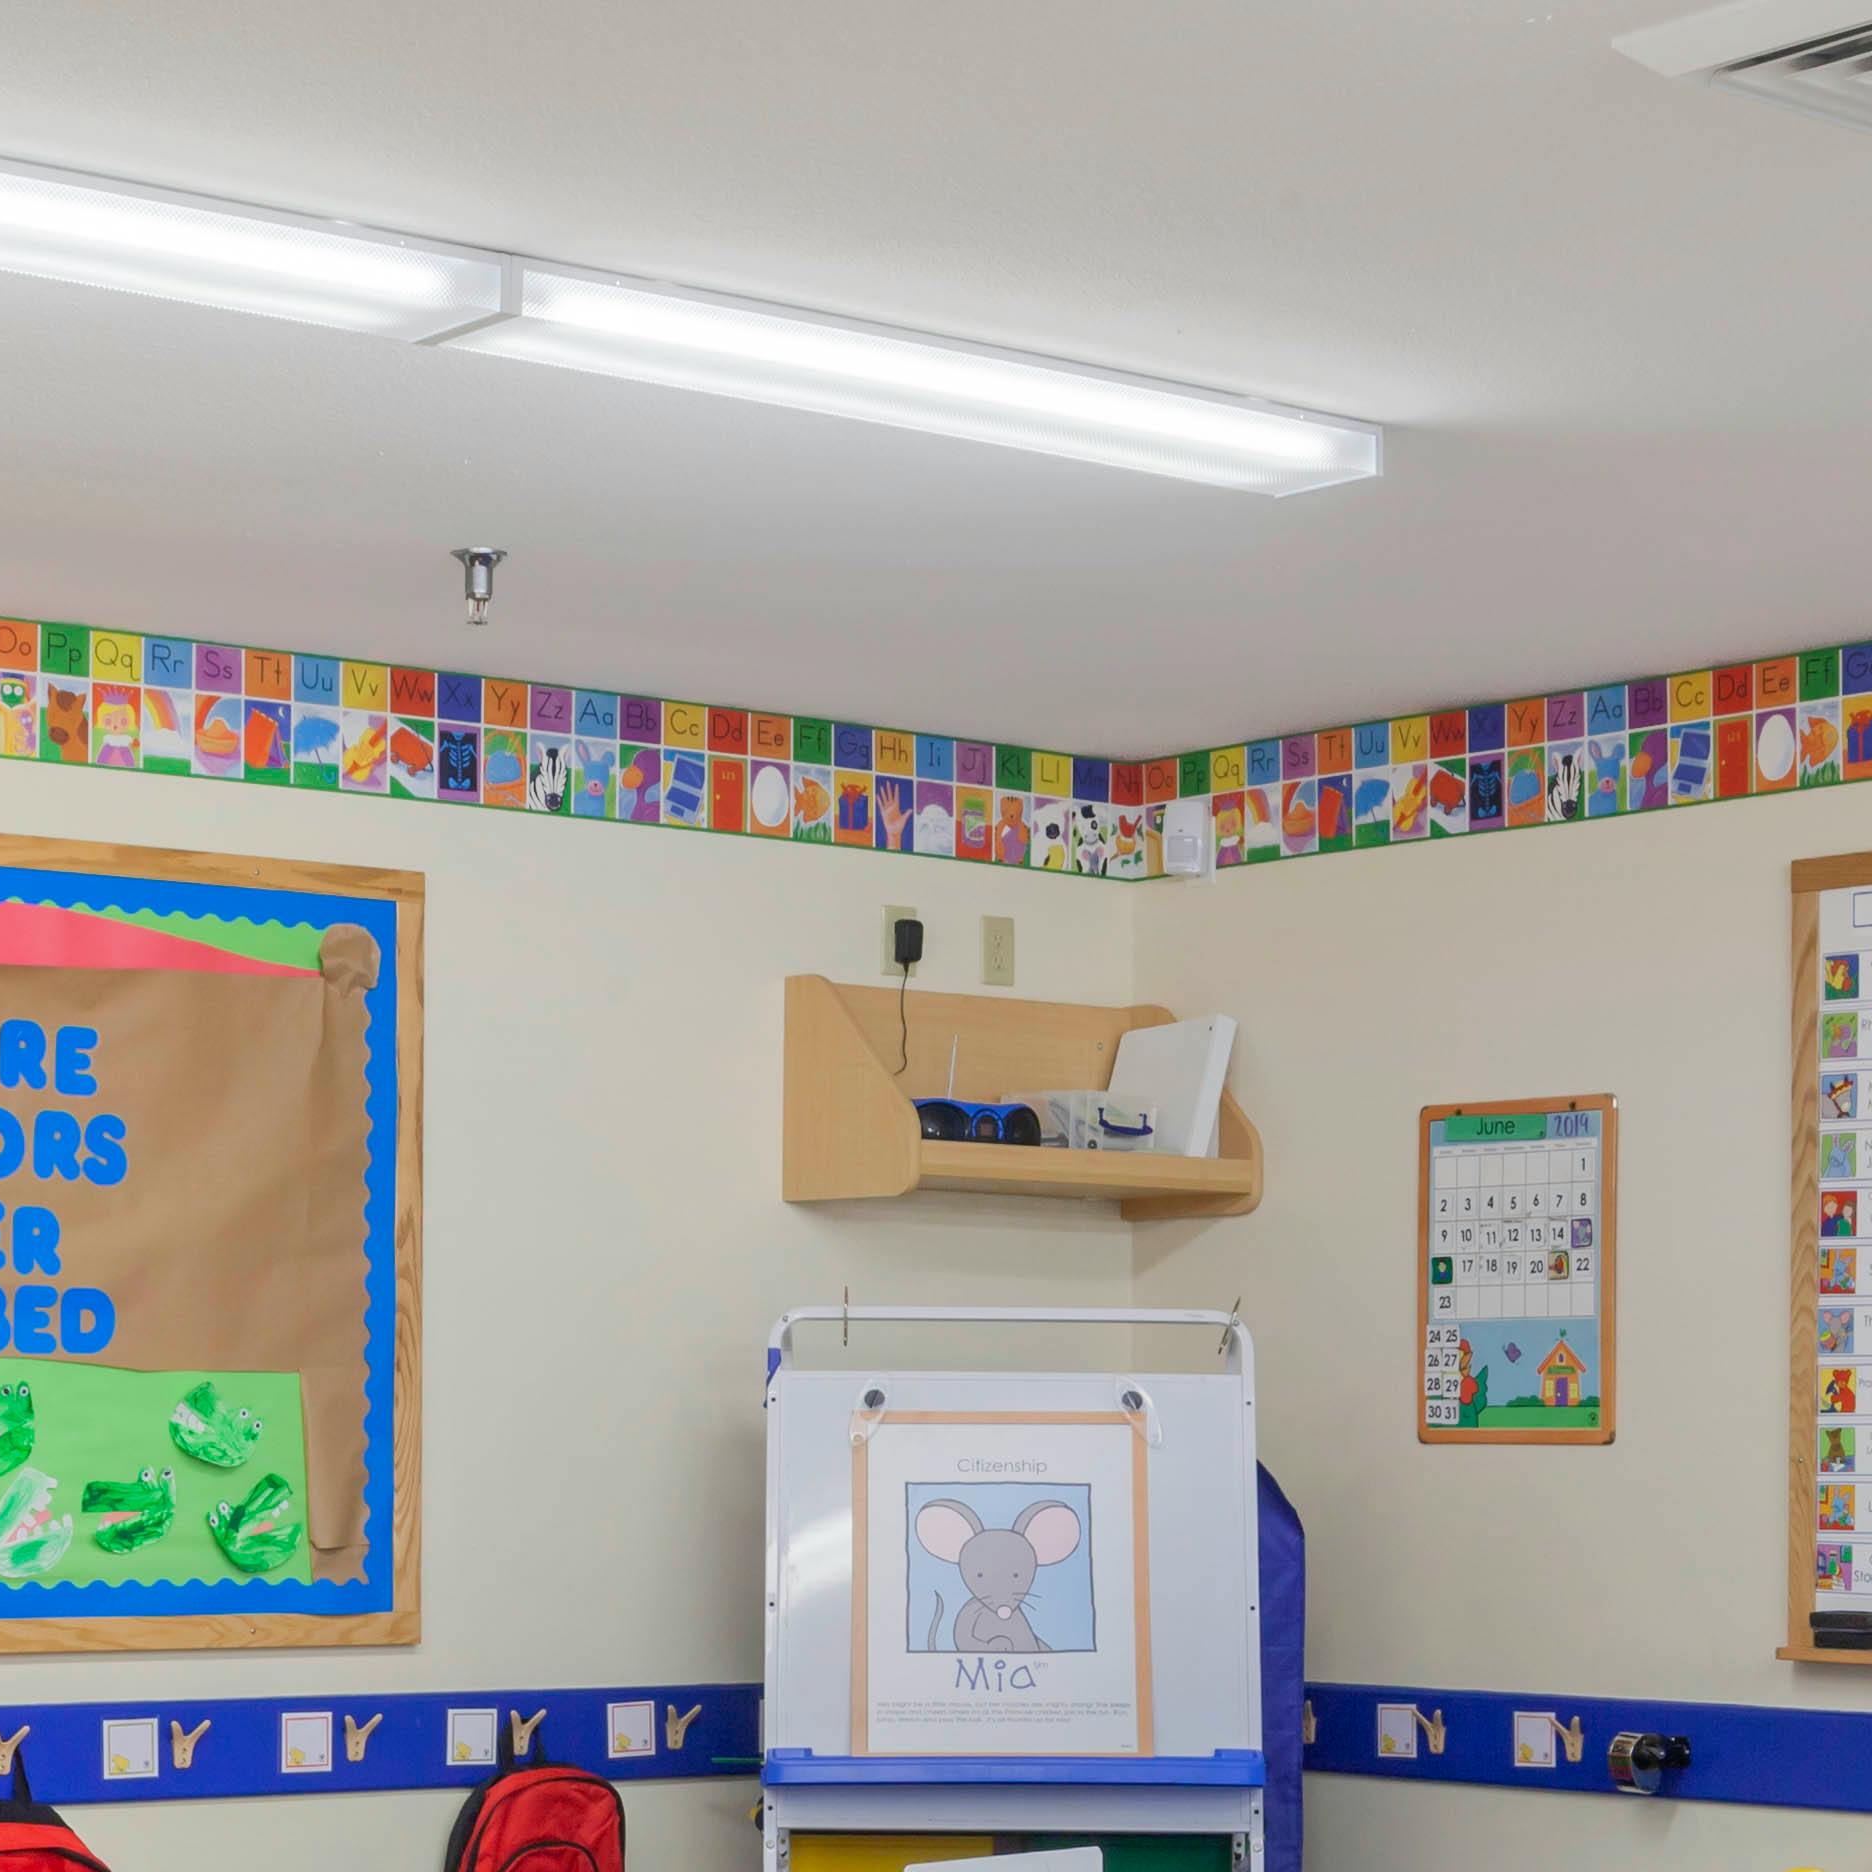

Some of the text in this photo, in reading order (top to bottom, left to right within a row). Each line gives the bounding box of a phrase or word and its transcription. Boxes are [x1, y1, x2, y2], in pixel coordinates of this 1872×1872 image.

[152, 644, 184, 672] Rr
[302, 662, 333, 692] Uu
[670, 708, 699, 736] Cc
[880, 736, 908, 762] Hh
[1250, 748, 1274, 773] Rr
[1398, 724, 1421, 748] Vv
[1592, 696, 1622, 719] Aa
[1762, 666, 1790, 694] Ee
[1477, 1114, 1589, 1138] June 2019
[1462, 1258, 1590, 1272] 17 18 22
[1439, 1296, 1452, 1309] 23
[1428, 1405, 1456, 1420] 30 31
[957, 1458, 1047, 1476] Citizenship
[956, 1657, 1036, 1692] Mia
